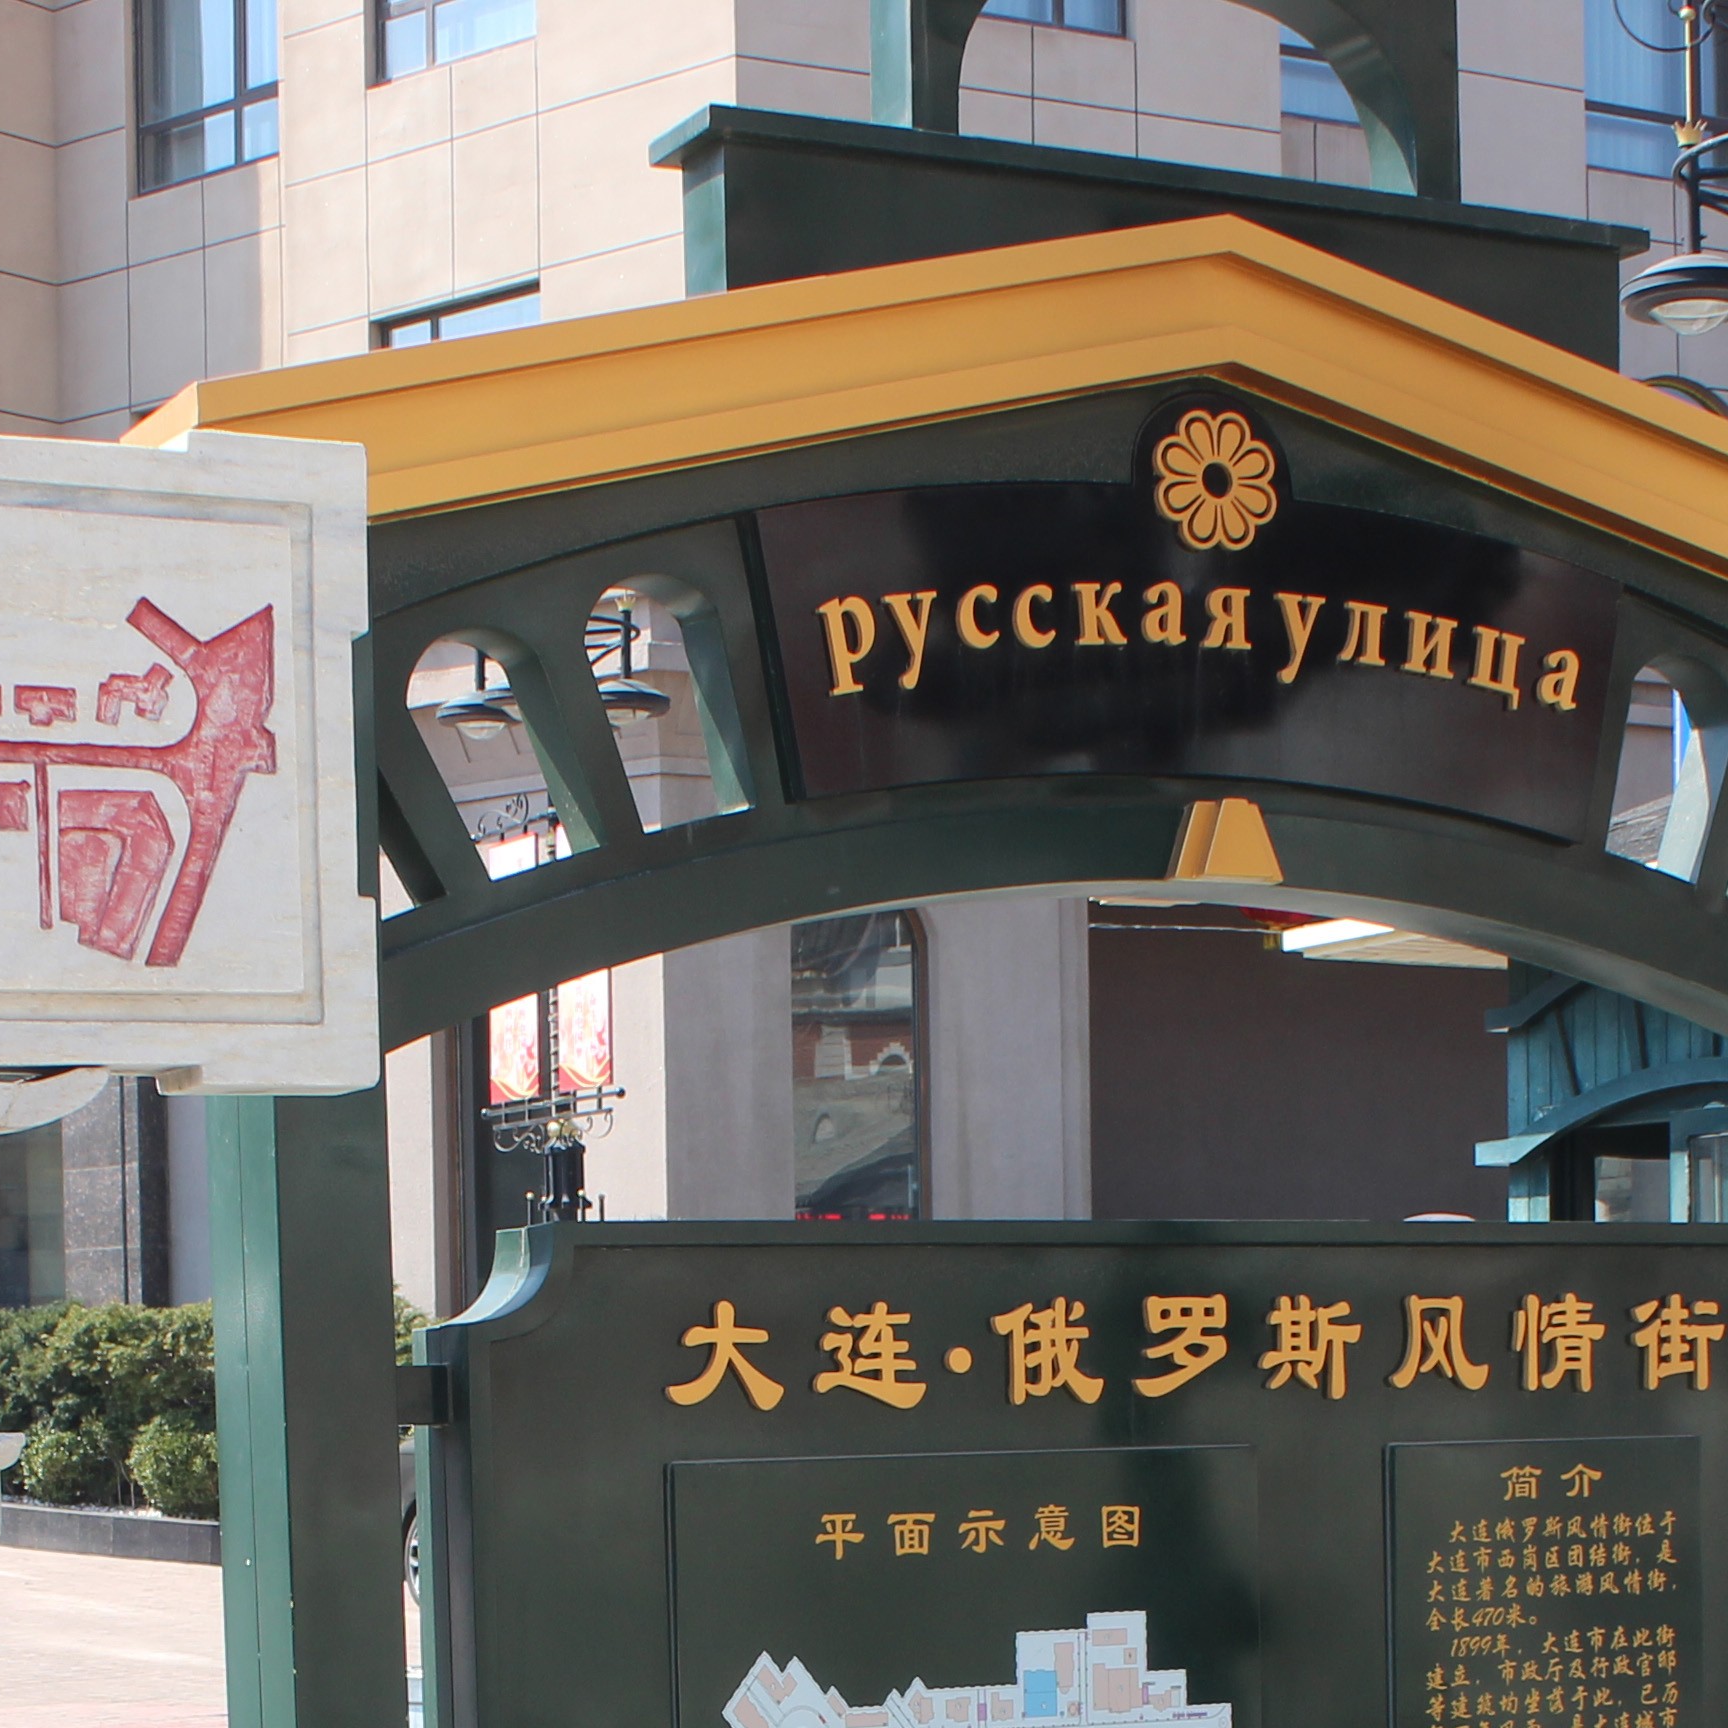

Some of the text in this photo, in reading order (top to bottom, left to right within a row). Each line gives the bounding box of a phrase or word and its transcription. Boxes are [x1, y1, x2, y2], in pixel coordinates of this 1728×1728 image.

[665, 1293, 1726, 1412] 大连·俄罗斯风情街
[1499, 1463, 1603, 1500] 简介
[814, 1503, 1142, 1560] 平面示意图
[1448, 1510, 1677, 1544] 大连俄罗斯风情街位于
[1425, 1603, 1538, 1632] 全长470米。
